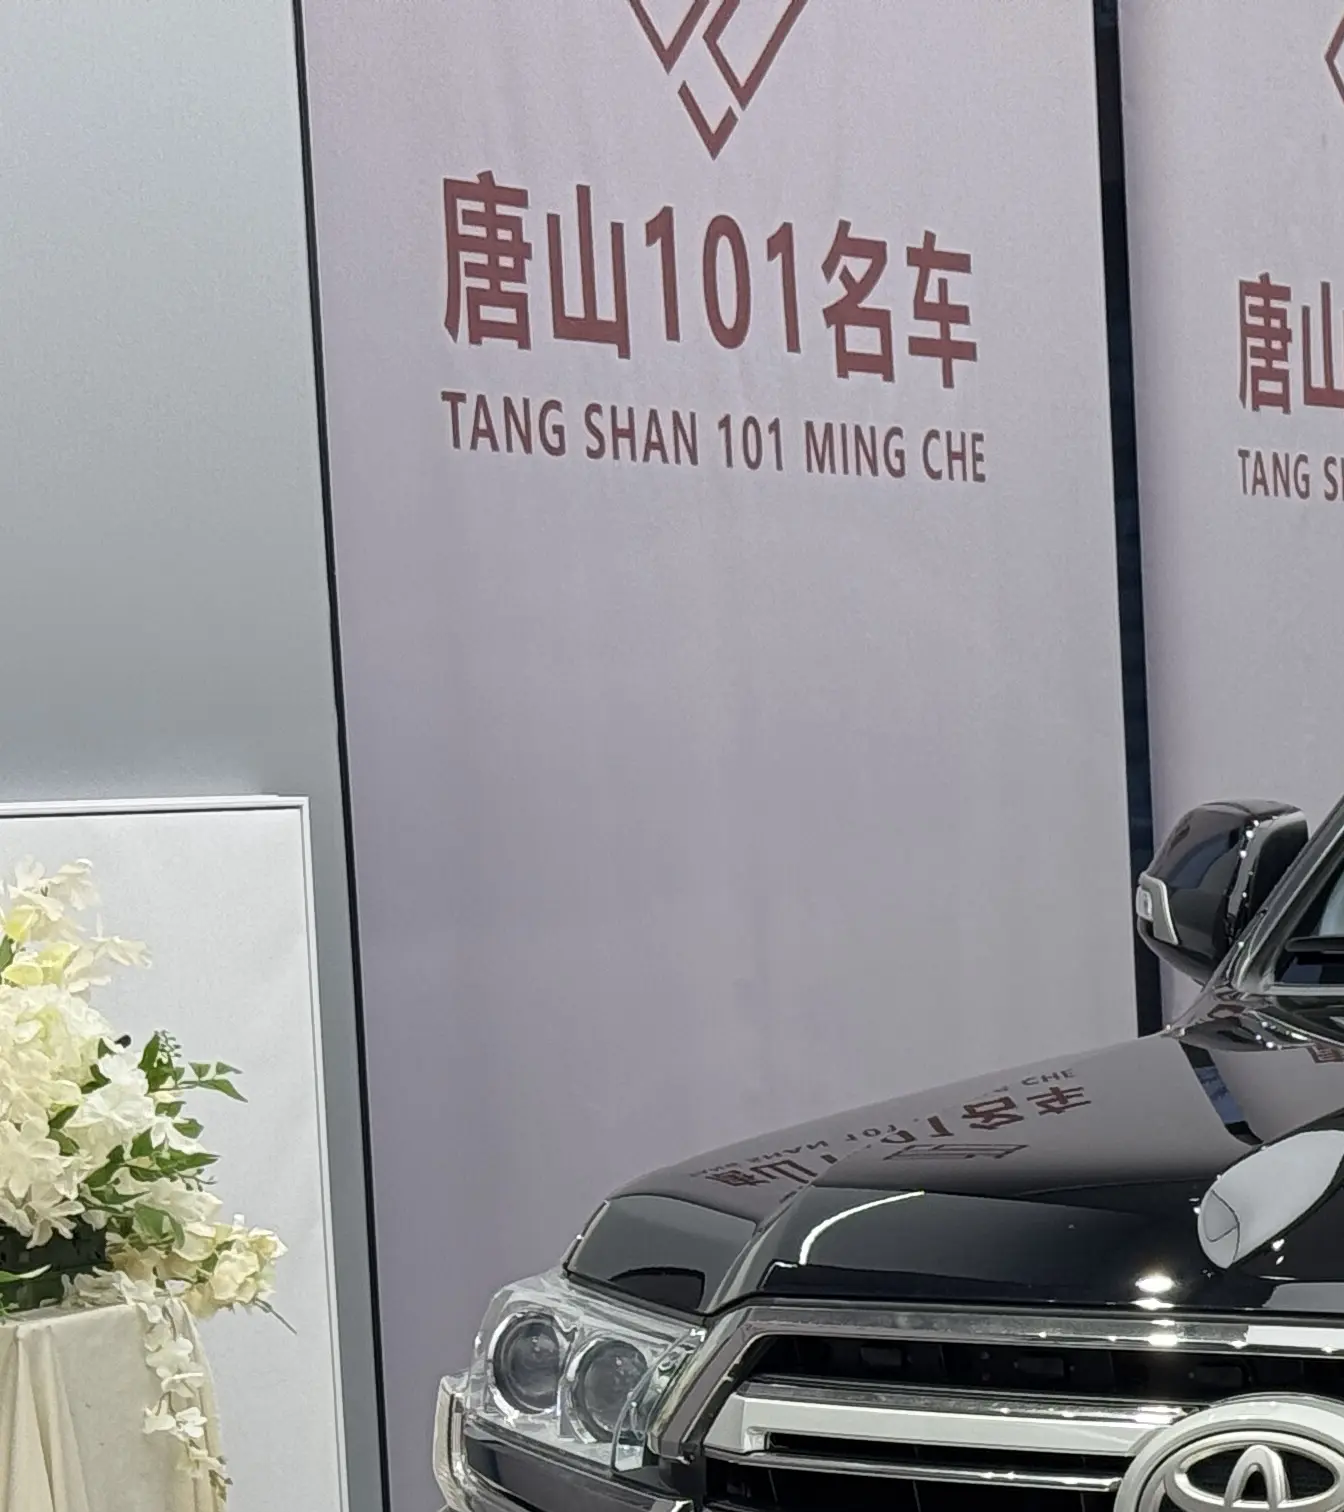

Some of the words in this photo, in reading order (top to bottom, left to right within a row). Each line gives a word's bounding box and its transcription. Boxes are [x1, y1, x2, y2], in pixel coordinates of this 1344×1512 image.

[442, 170, 978, 389] 唐山101名车
[440, 390, 566, 457] TANG
[584, 402, 699, 467] SHAN
[717, 413, 784, 472] 101
[804, 420, 906, 479] MING
[922, 428, 986, 483] CHE
[1237, 448, 1311, 500] TANG
